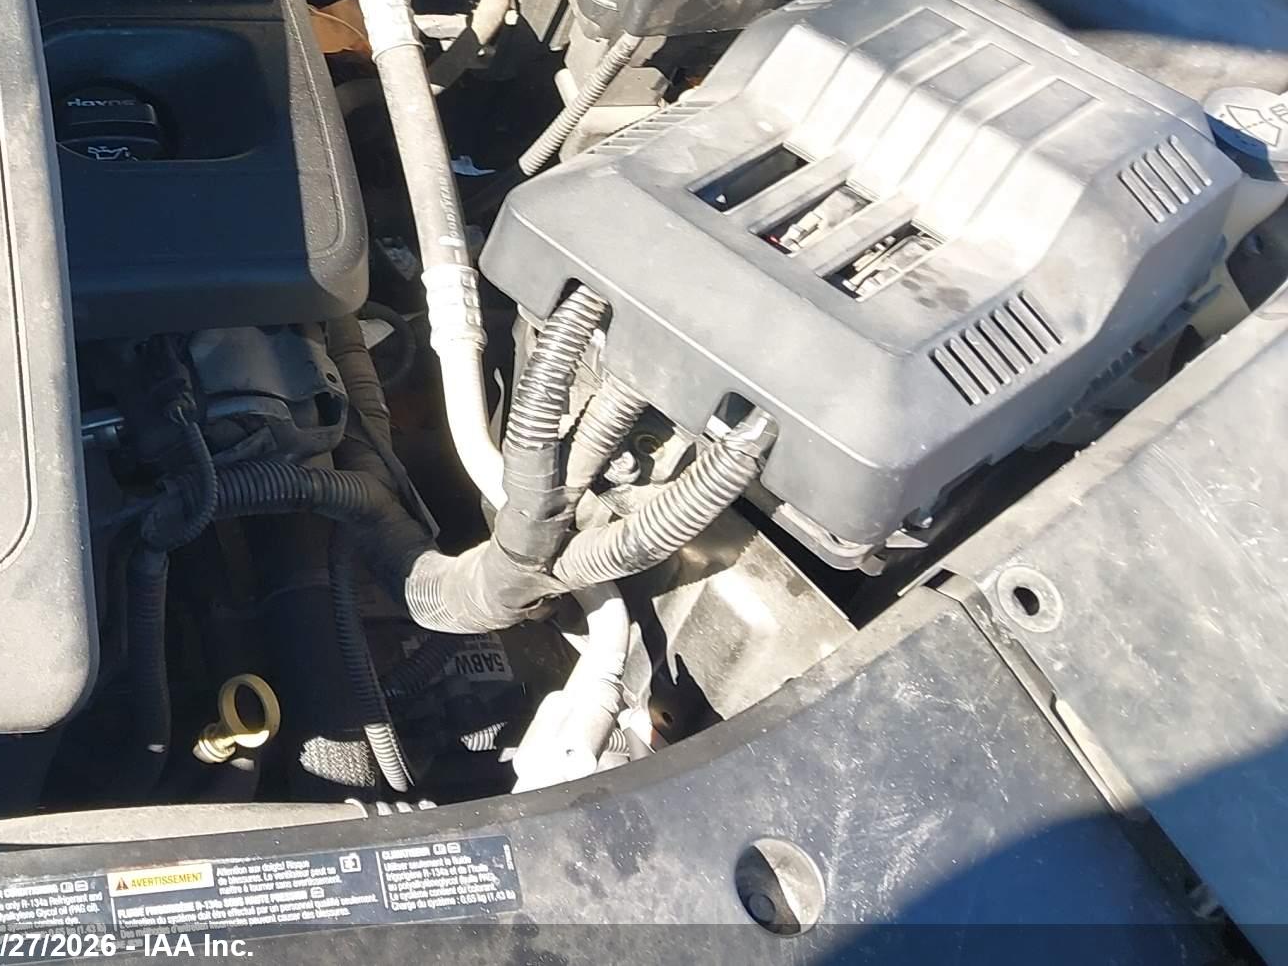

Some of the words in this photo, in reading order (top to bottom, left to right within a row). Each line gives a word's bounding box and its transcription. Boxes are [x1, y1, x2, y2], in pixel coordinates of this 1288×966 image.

[455, 652, 506, 675] 5ABW
[131, 872, 202, 888] AVERTISSEMENT
[21, 898, 47, 907] R-134a
